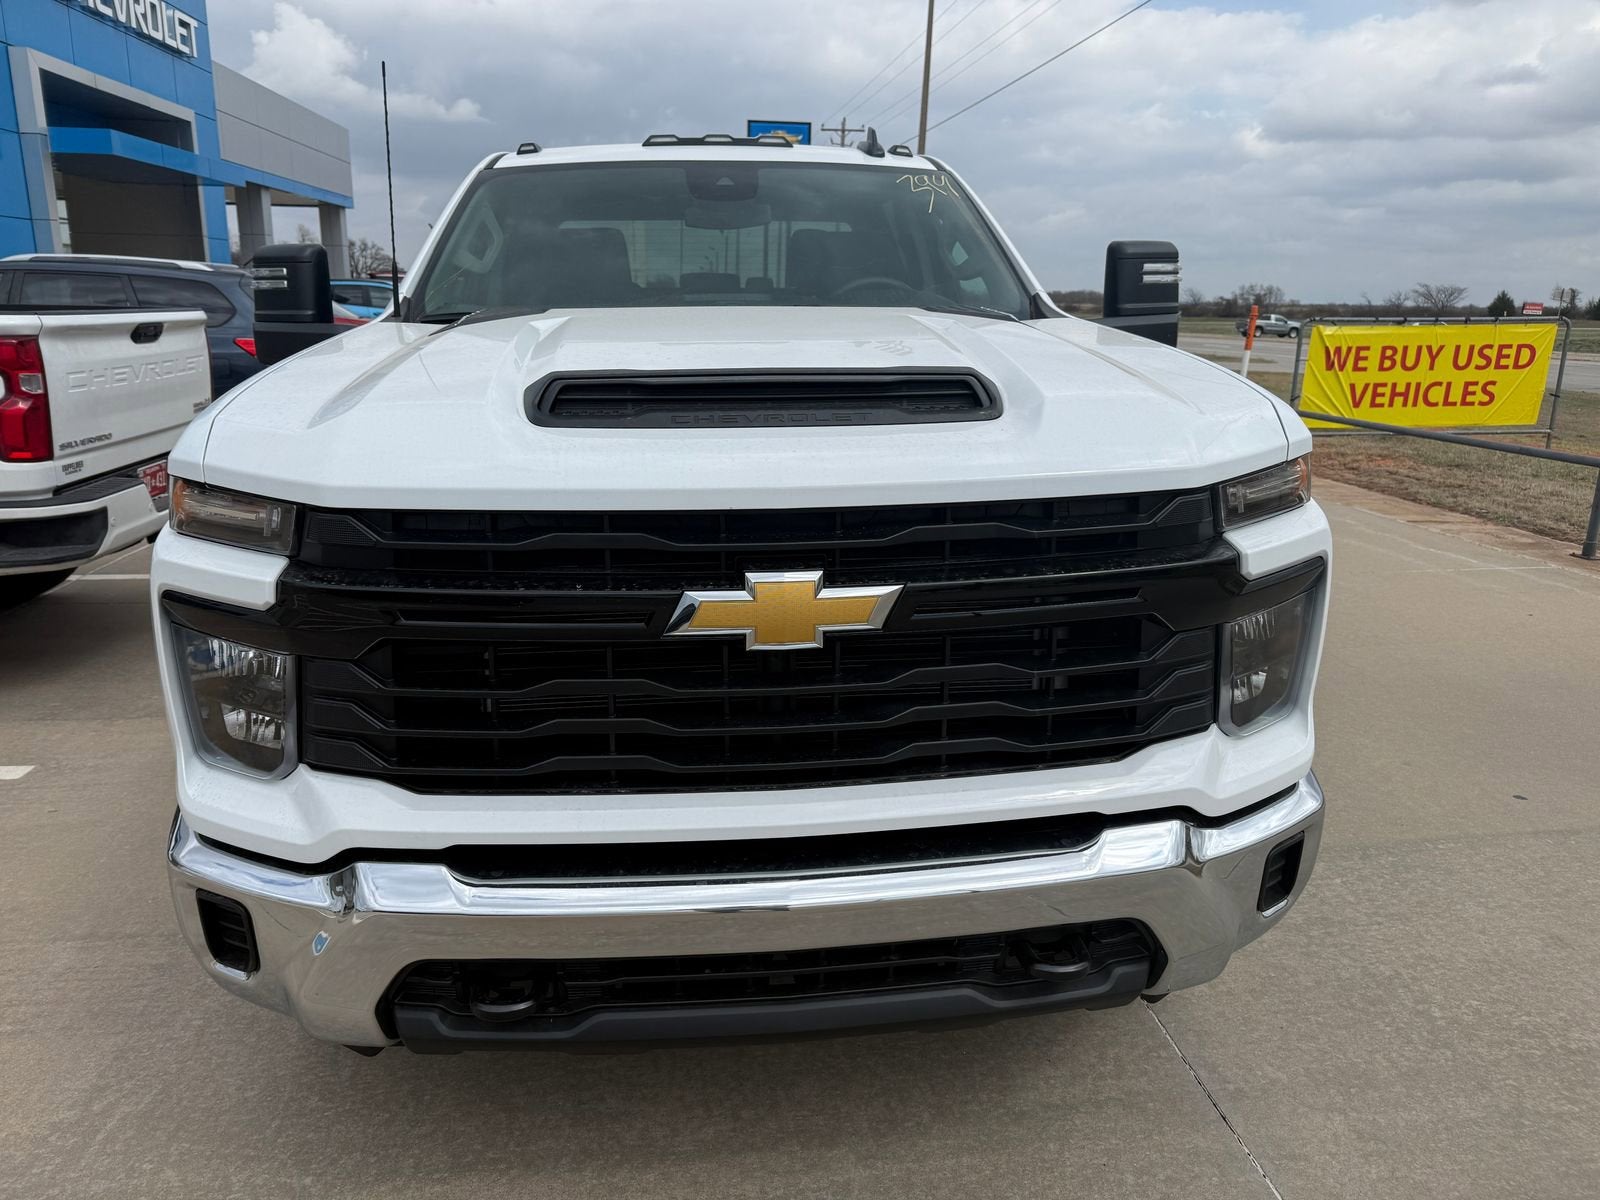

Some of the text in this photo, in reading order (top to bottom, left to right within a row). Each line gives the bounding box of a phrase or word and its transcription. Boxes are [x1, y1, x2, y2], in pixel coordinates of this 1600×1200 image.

[1324, 343, 1537, 372] WE BUY USED
[65, 354, 204, 393] CHEVROLET
[1349, 380, 1497, 409] VEHICLES
[670, 412, 873, 425] CHEVROLET
[58, 432, 113, 451] SILVERADO
